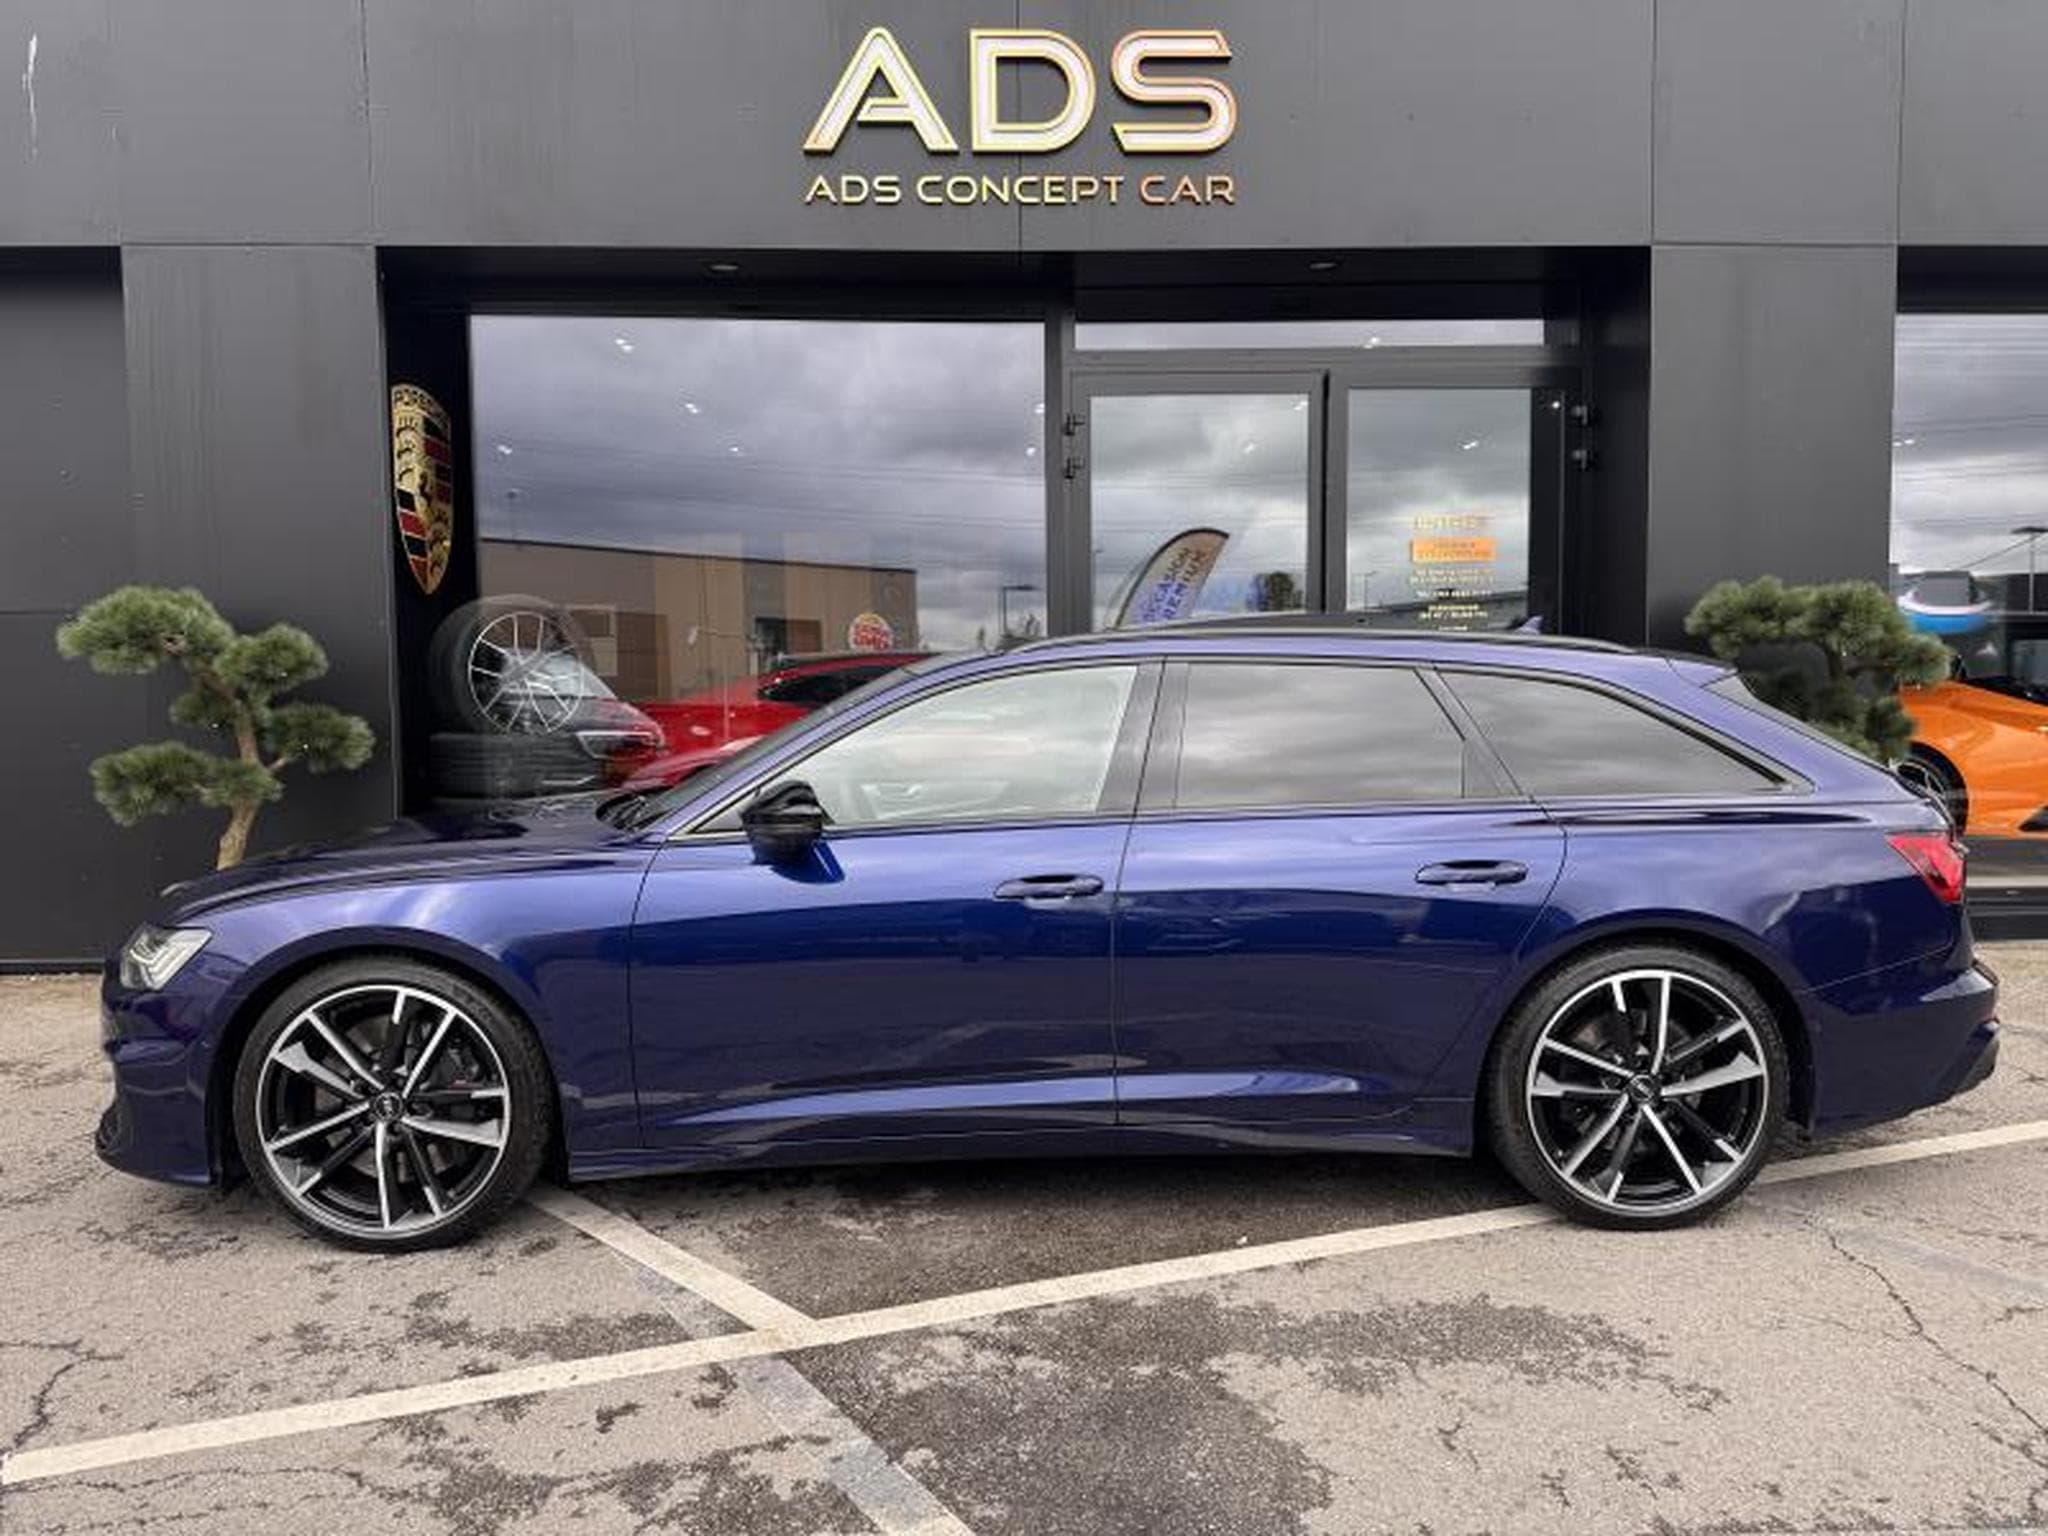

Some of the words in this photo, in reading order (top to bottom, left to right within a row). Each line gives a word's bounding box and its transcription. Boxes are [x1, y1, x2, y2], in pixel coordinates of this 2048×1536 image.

[803, 26, 1239, 153] ADS
[804, 175, 901, 204] ADS
[916, 175, 1126, 205] CONCEPT
[1139, 175, 1236, 205] CAR
